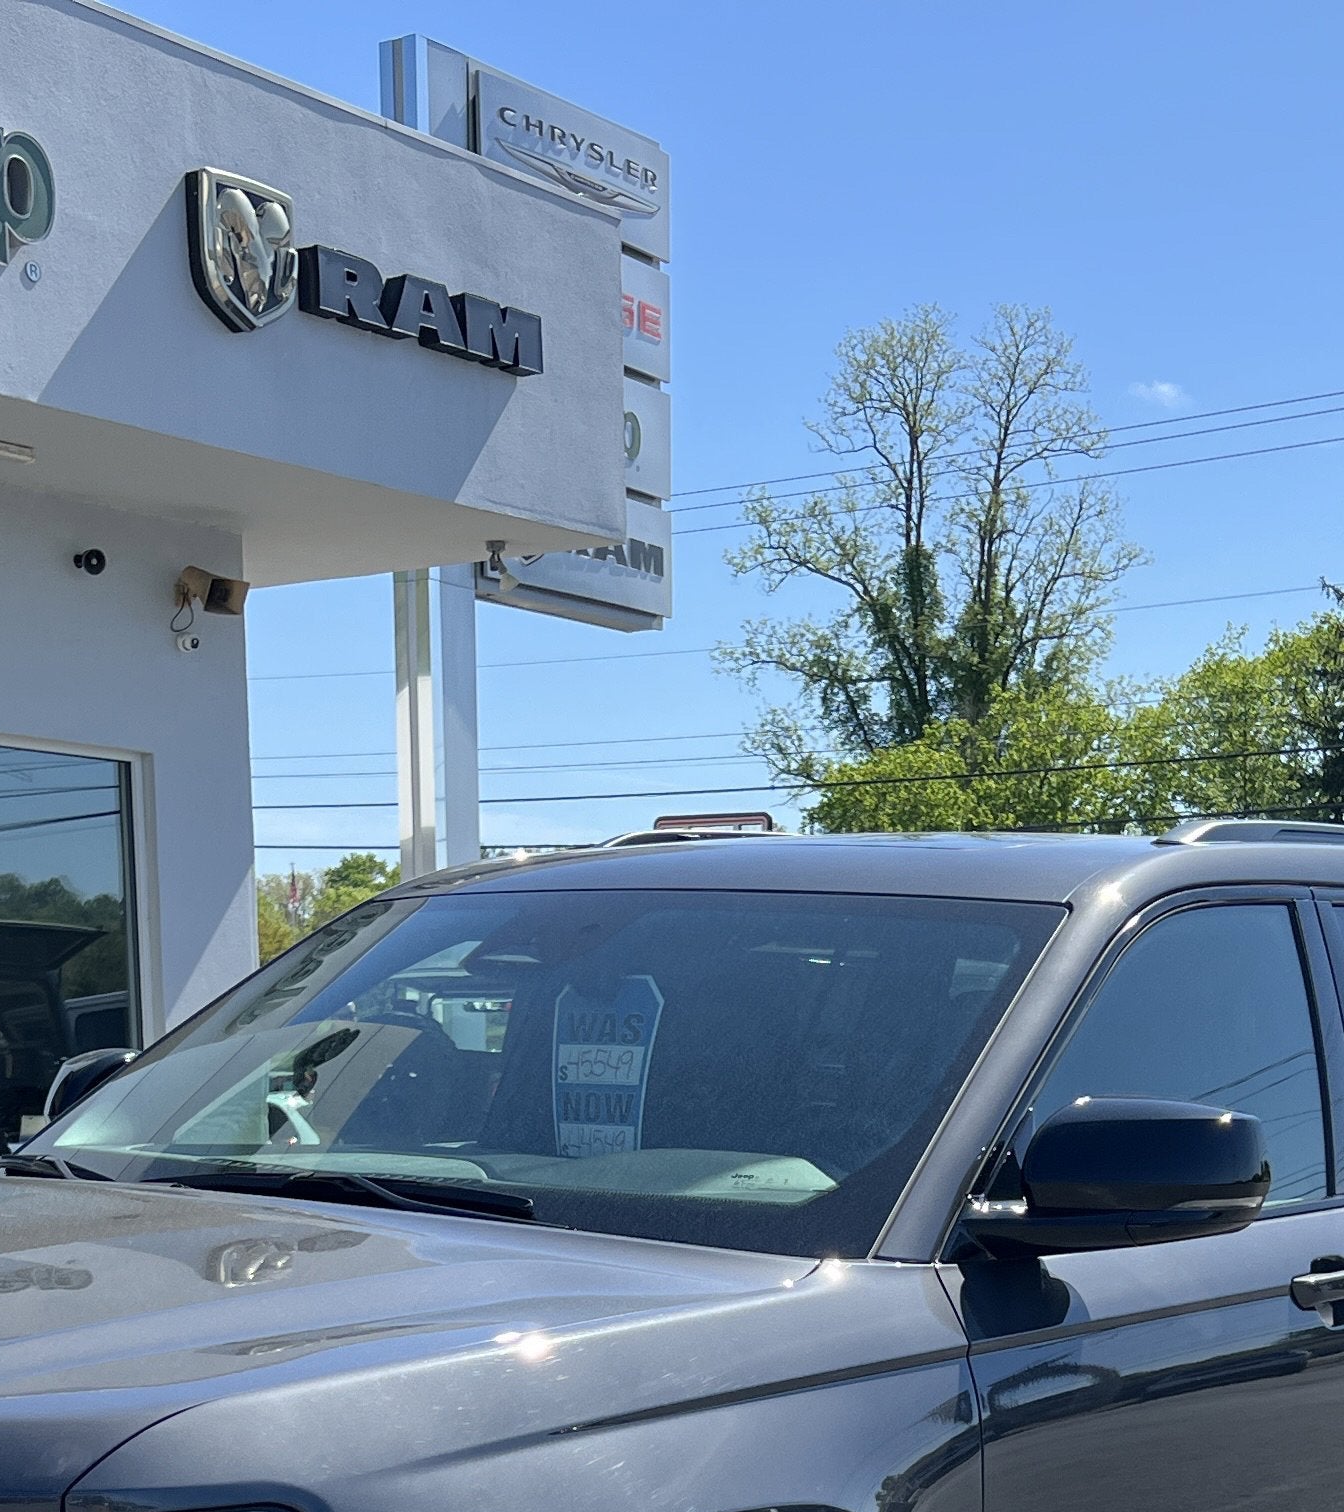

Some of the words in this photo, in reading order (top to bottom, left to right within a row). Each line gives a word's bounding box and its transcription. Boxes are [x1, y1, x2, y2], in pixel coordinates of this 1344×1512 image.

[498, 107, 657, 190] CHRYSLER
[301, 245, 544, 377] RAM
[568, 1011, 644, 1045] WAS
[562, 1091, 635, 1124] NOW
